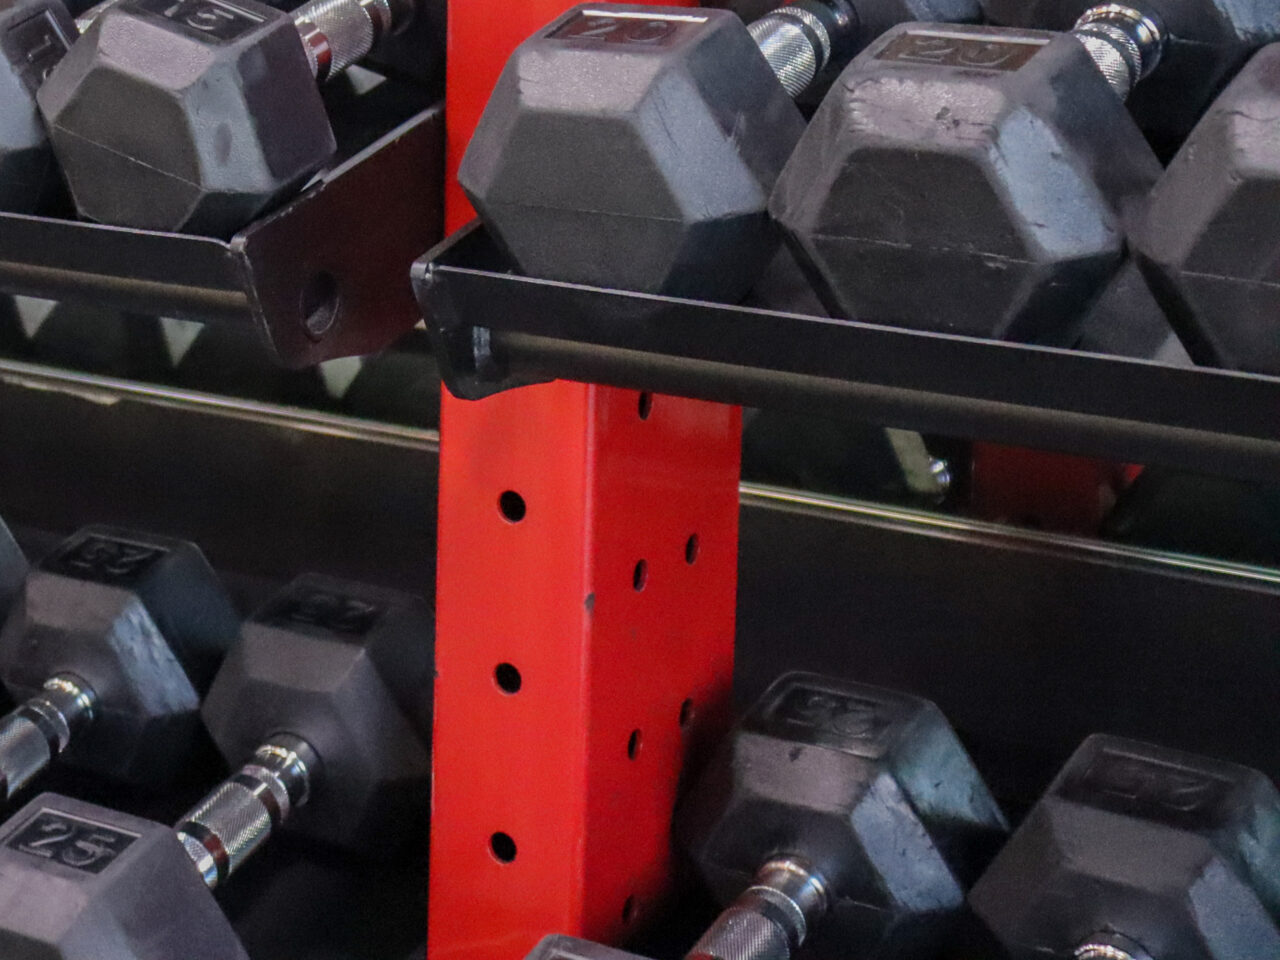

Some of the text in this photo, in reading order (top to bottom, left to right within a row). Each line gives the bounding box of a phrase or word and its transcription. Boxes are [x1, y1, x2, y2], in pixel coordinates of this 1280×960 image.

[567, 17, 678, 43] 20
[897, 38, 1018, 68] 20
[18, 819, 119, 867] 25
